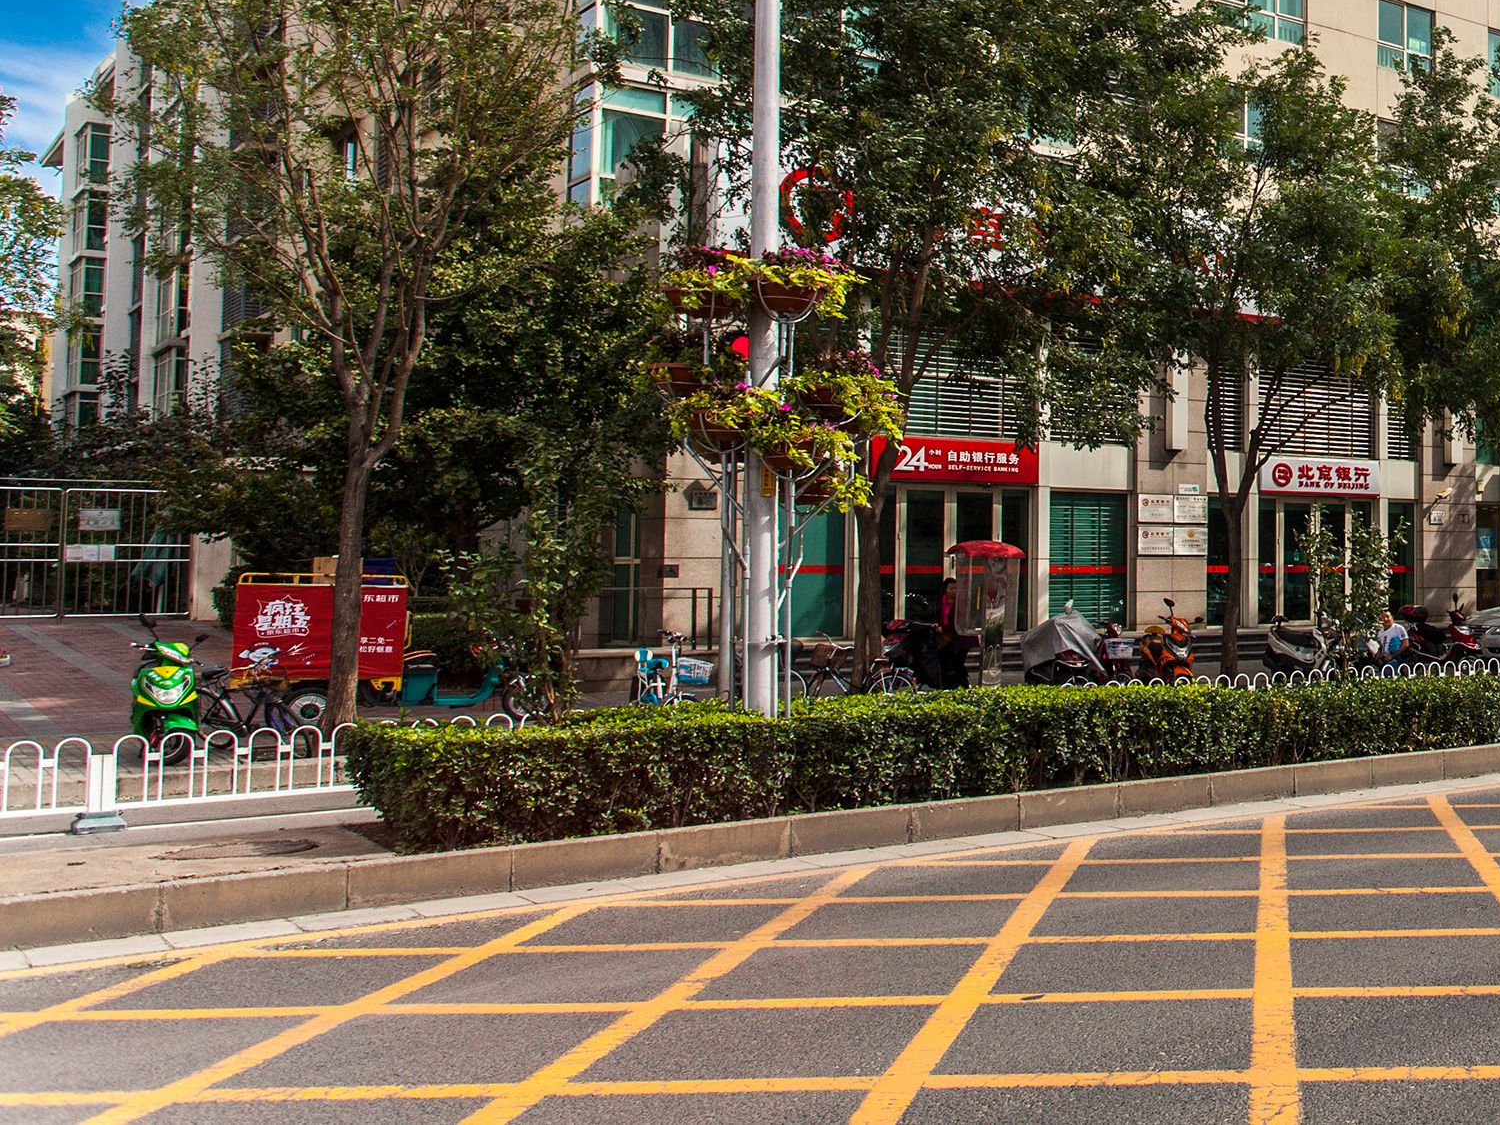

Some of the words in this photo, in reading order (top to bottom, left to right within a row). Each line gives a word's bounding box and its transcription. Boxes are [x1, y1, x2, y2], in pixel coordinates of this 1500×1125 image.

[894, 445, 928, 472] 24
[947, 450, 1020, 465] 自助银行服务
[1298, 464, 1371, 483] 北京银行
[1298, 480, 1321, 489] BANK
[1337, 482, 1370, 491] BEIJING
[262, 599, 305, 615] 疯狂
[254, 615, 311, 630] 星期五
